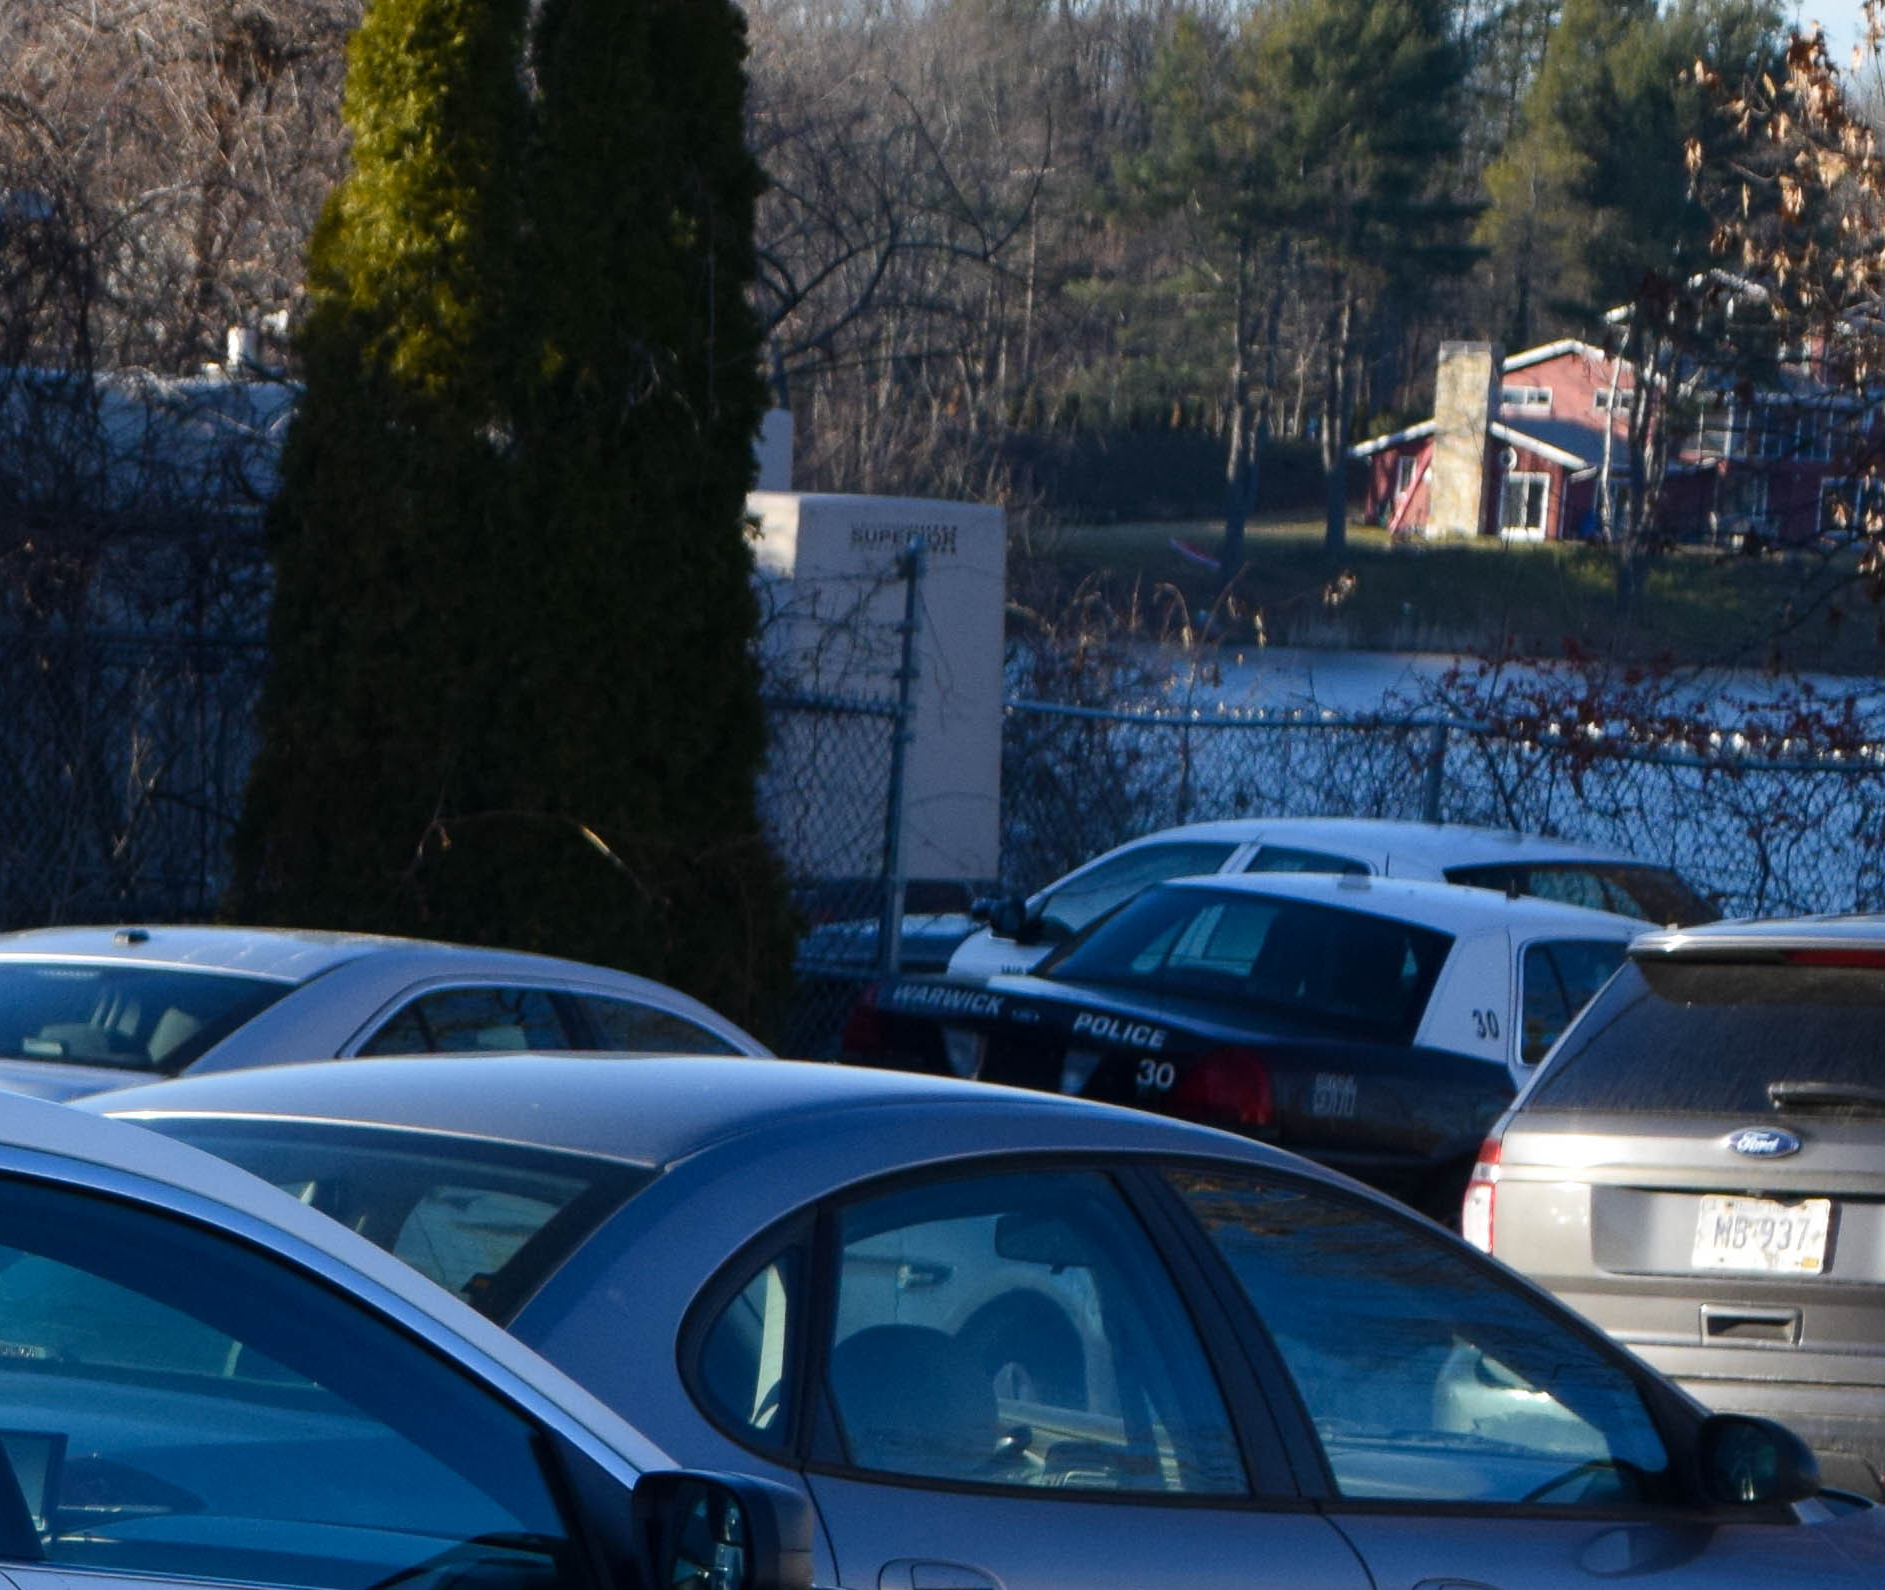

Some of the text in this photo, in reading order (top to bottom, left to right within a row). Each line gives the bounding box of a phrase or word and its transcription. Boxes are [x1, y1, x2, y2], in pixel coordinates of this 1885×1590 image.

[892, 983, 1167, 1049] WARWICK POLICE
[1472, 1008, 1499, 1040] 30
[1136, 1058, 1176, 1089] 30
[1737, 1131, 1780, 1153] Ford
